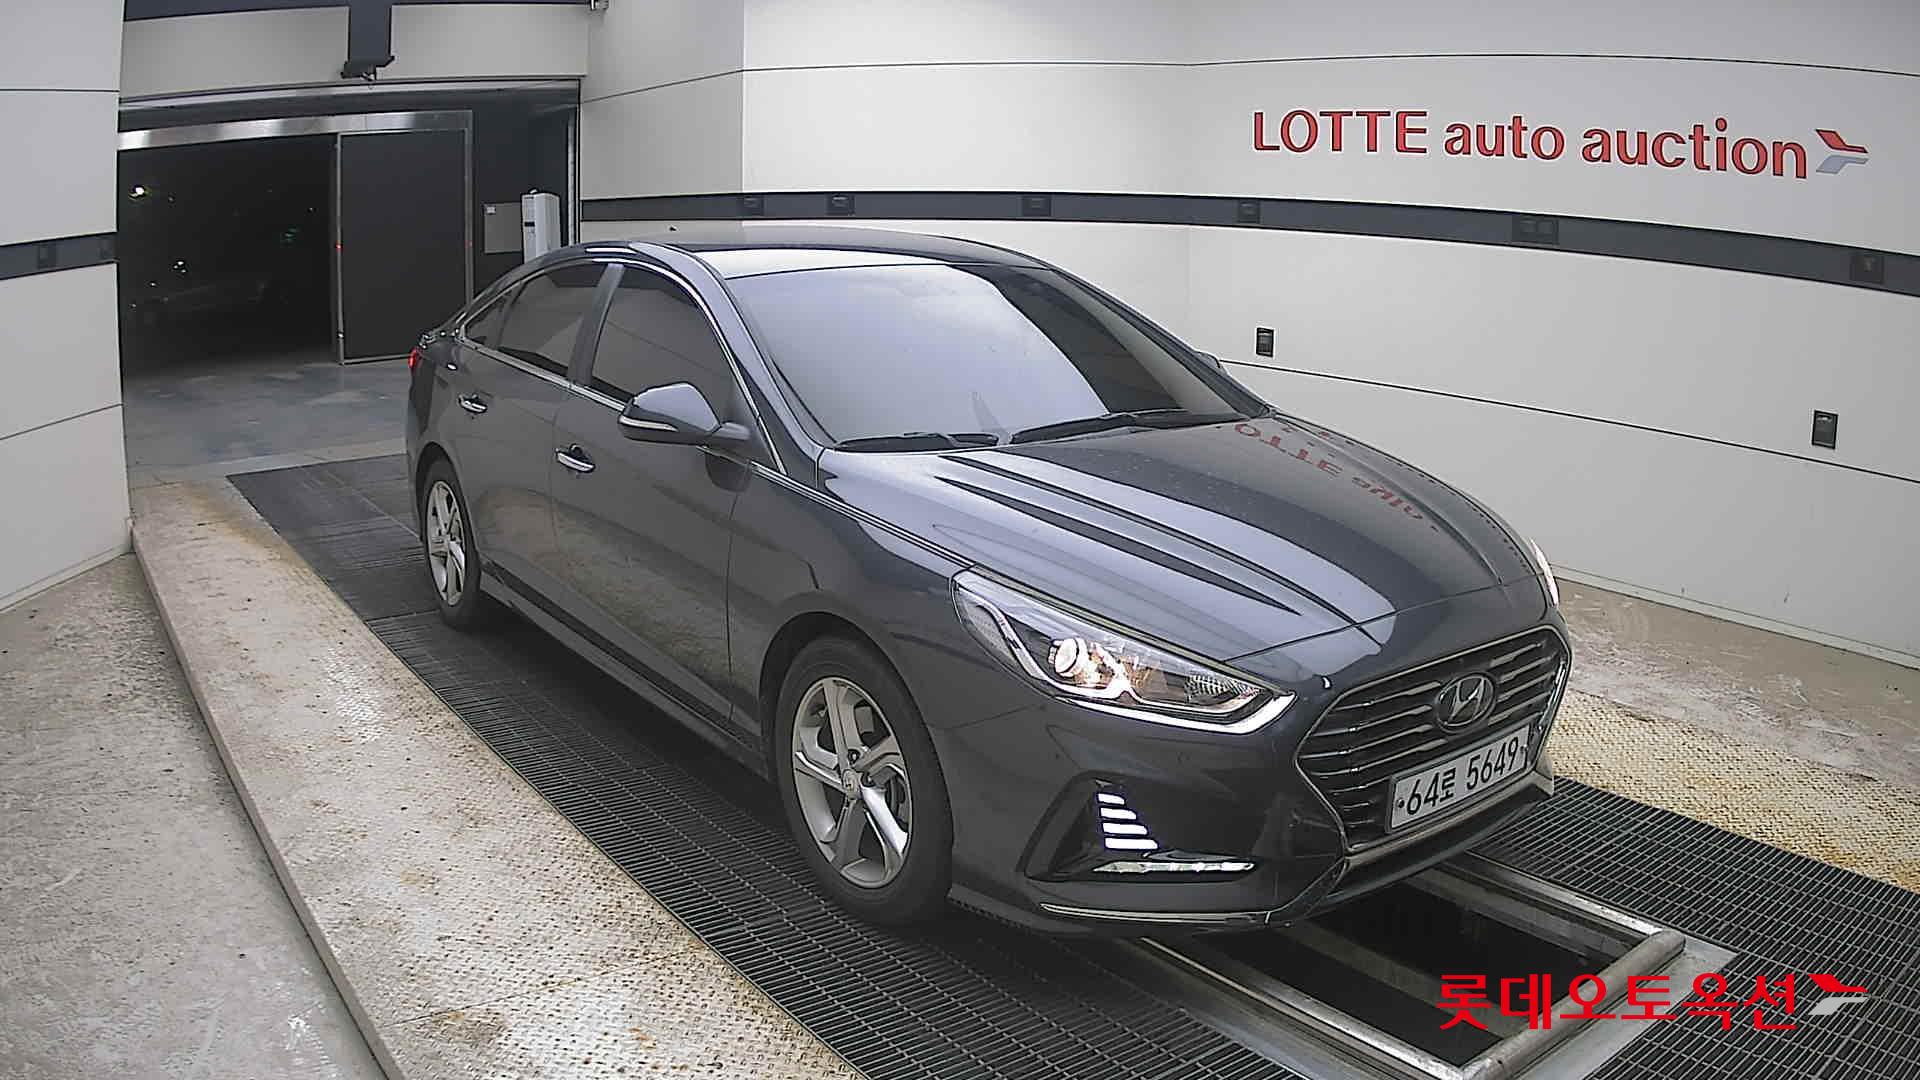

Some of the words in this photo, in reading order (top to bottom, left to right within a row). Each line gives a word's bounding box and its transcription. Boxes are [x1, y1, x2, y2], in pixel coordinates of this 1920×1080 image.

[1254, 110, 1428, 153] LOTTE
[1444, 115, 1565, 159] auto
[1581, 117, 1808, 179] auction
[1406, 767, 1456, 815] 64로
[1466, 736, 1519, 790] 5649
